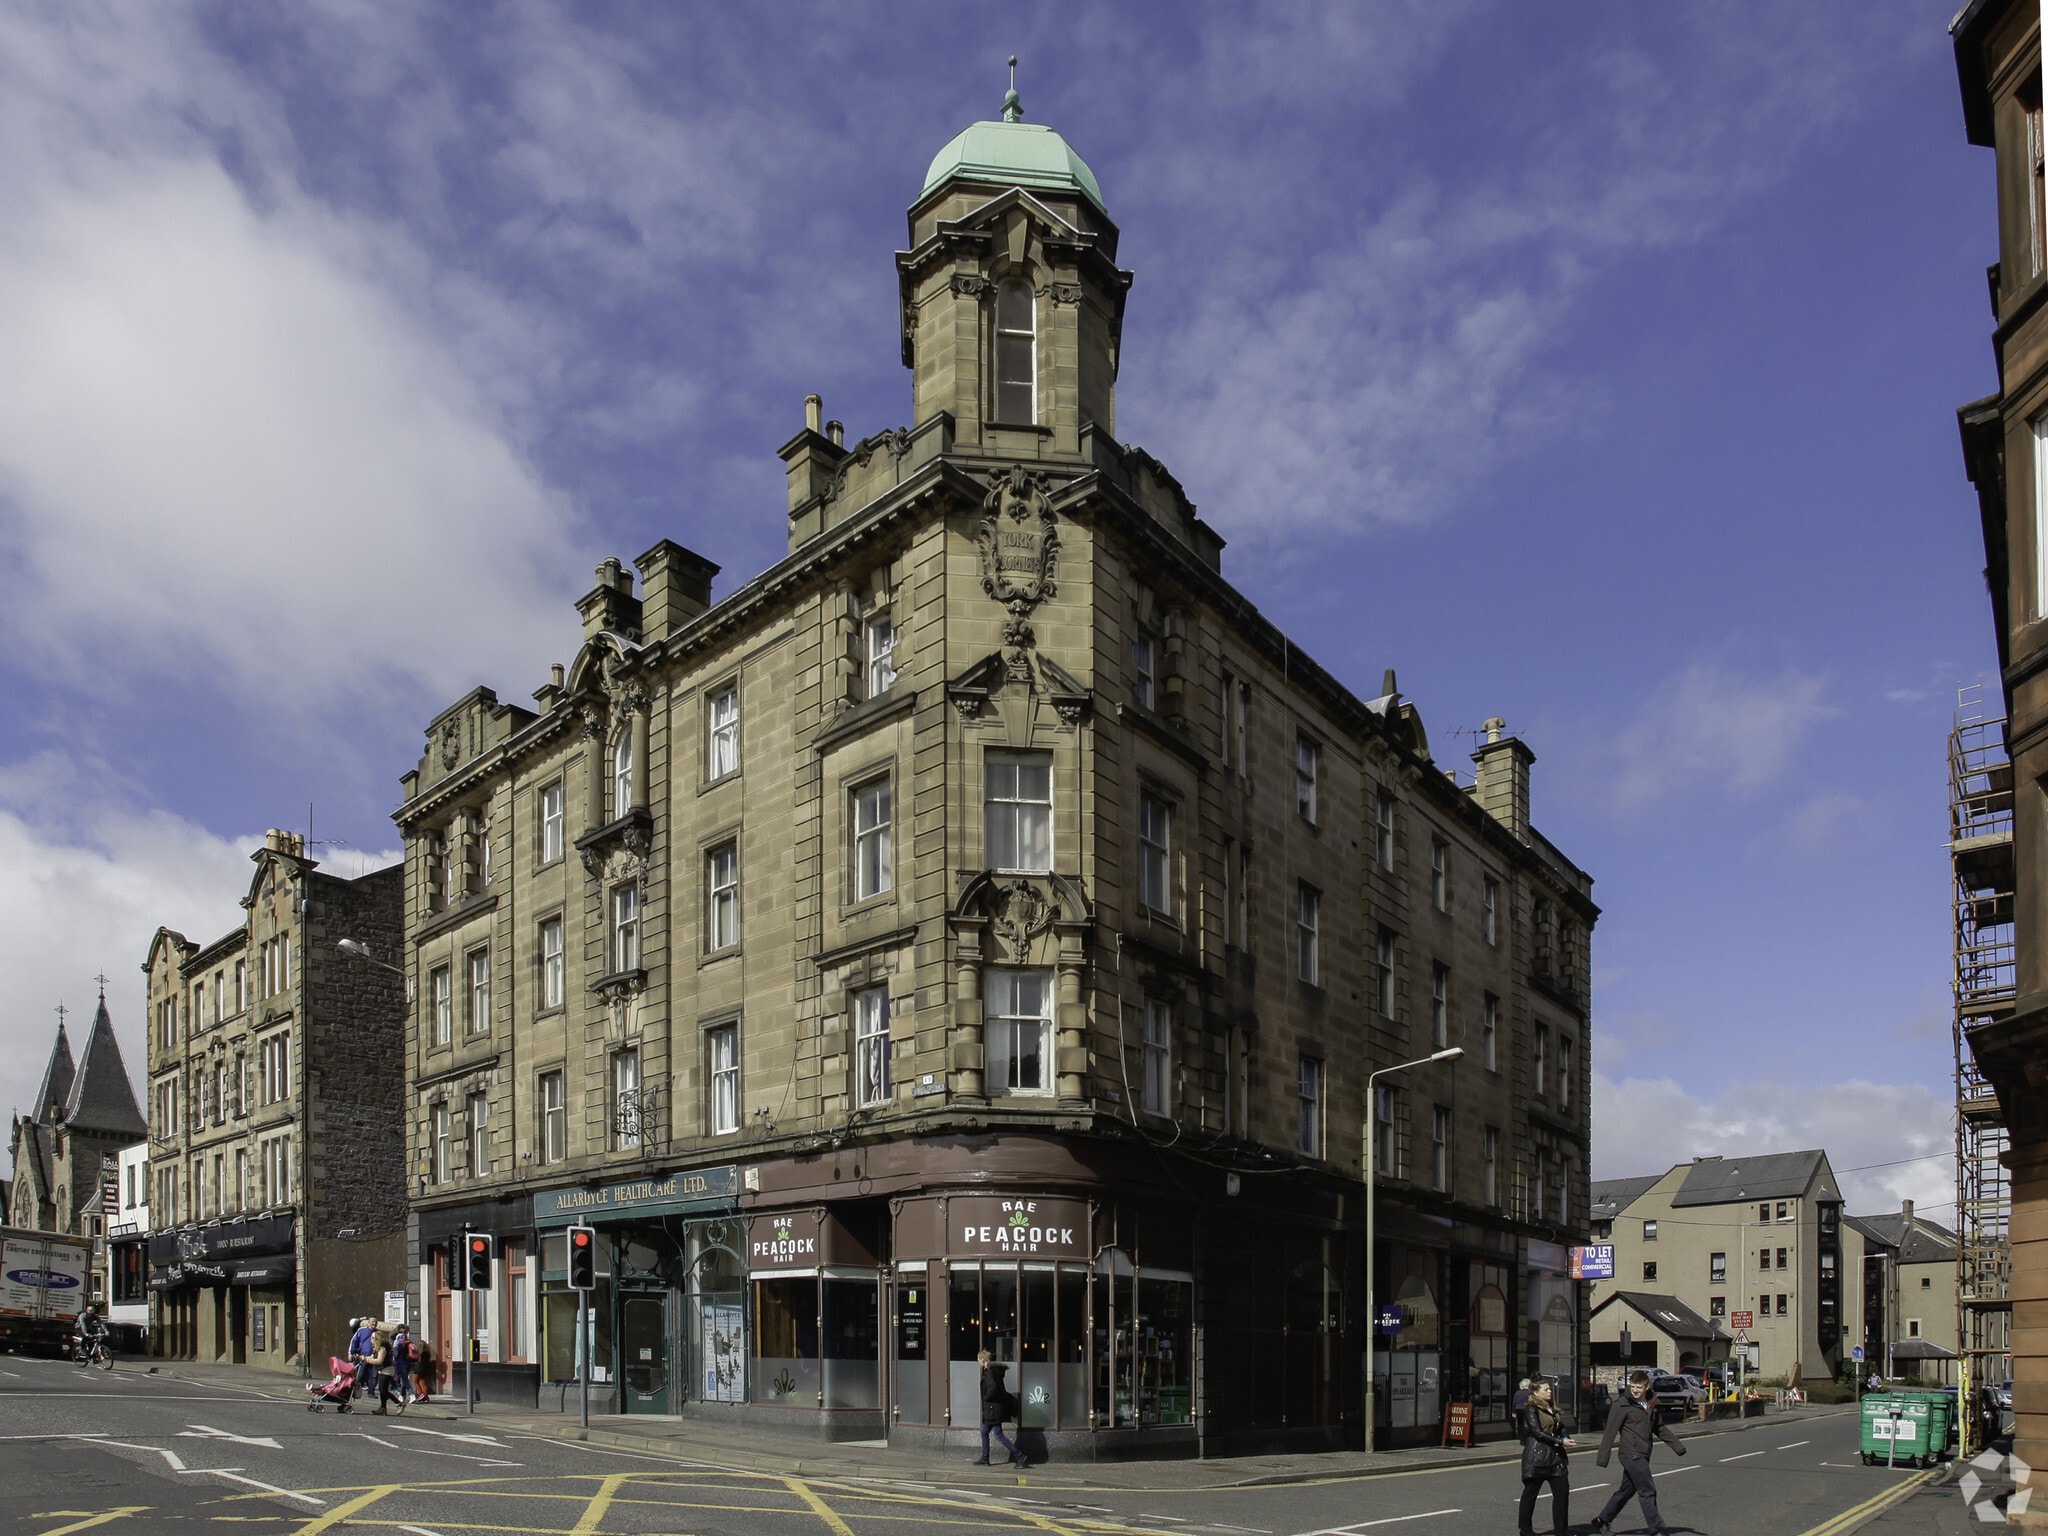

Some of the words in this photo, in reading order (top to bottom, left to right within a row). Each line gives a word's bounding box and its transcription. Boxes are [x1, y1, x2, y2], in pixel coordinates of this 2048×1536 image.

[1002, 533, 1034, 550] YORK
[556, 1188, 608, 1208] ALLARDYCE
[614, 1179, 676, 1202] HEALTHCARE
[684, 1176, 707, 1194] LTD.
[1002, 1201, 1036, 1212] RAE
[774, 1218, 792, 1228] RAE
[964, 1226, 1072, 1244] PEACOCK
[754, 1238, 814, 1256] PEACOCK
[1002, 1242, 1036, 1252] HAIR
[1584, 1247, 1596, 1258] TO
[1598, 1246, 1612, 1258] LET
[774, 1254, 793, 1262] HAIR
[1450, 1406, 1468, 1414] ARDINE
